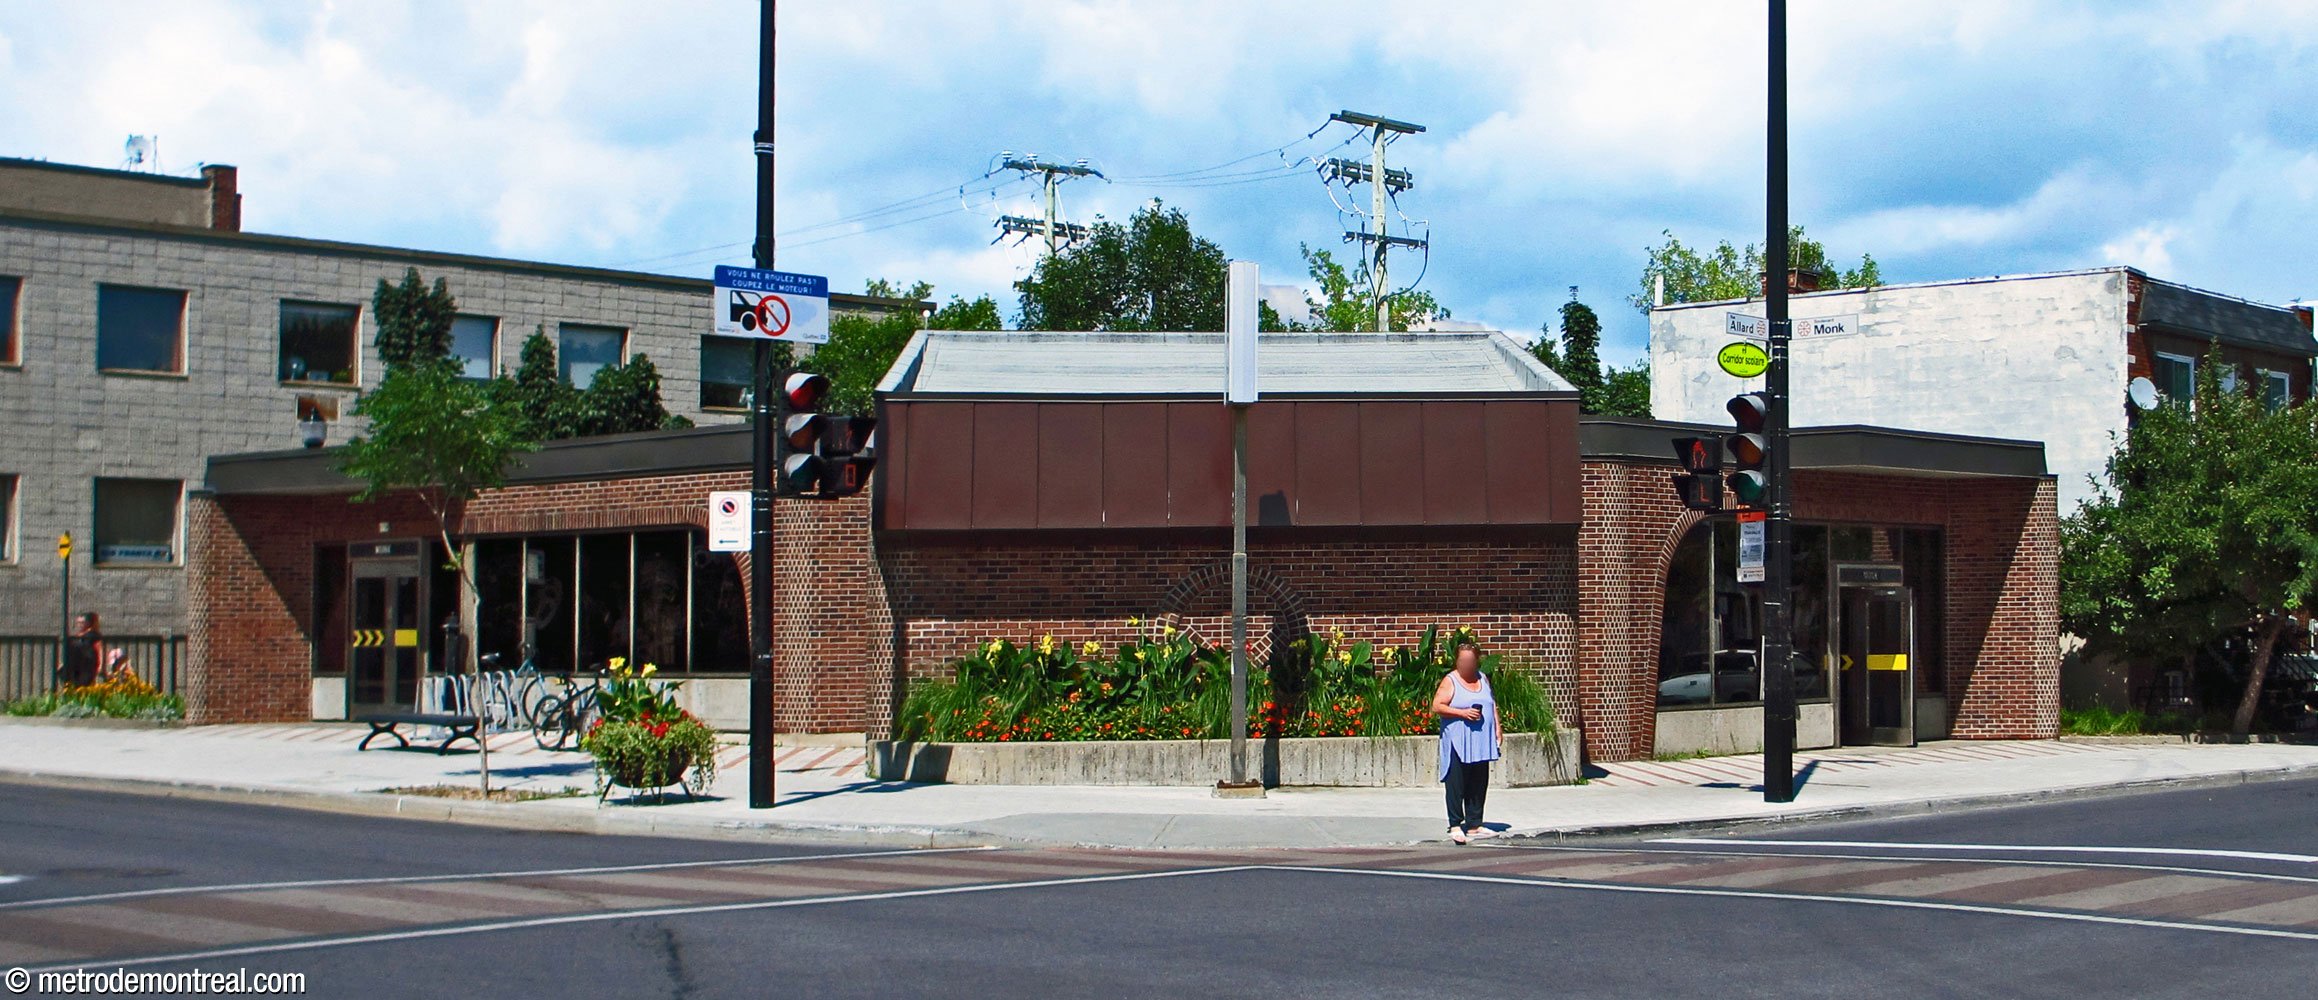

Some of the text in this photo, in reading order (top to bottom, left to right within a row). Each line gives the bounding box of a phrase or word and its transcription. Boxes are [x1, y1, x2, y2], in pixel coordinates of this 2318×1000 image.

[727, 269, 748, 278] VOUS
[751, 271, 761, 280] NE
[765, 273, 795, 283] ROULEZ
[732, 279, 762, 289] COUPEZ
[766, 282, 775, 291] LE
[1730, 320, 1754, 334] Allard
[1813, 322, 1845, 335] Monk
[1722, 352, 1765, 367] Corridor scolaire
